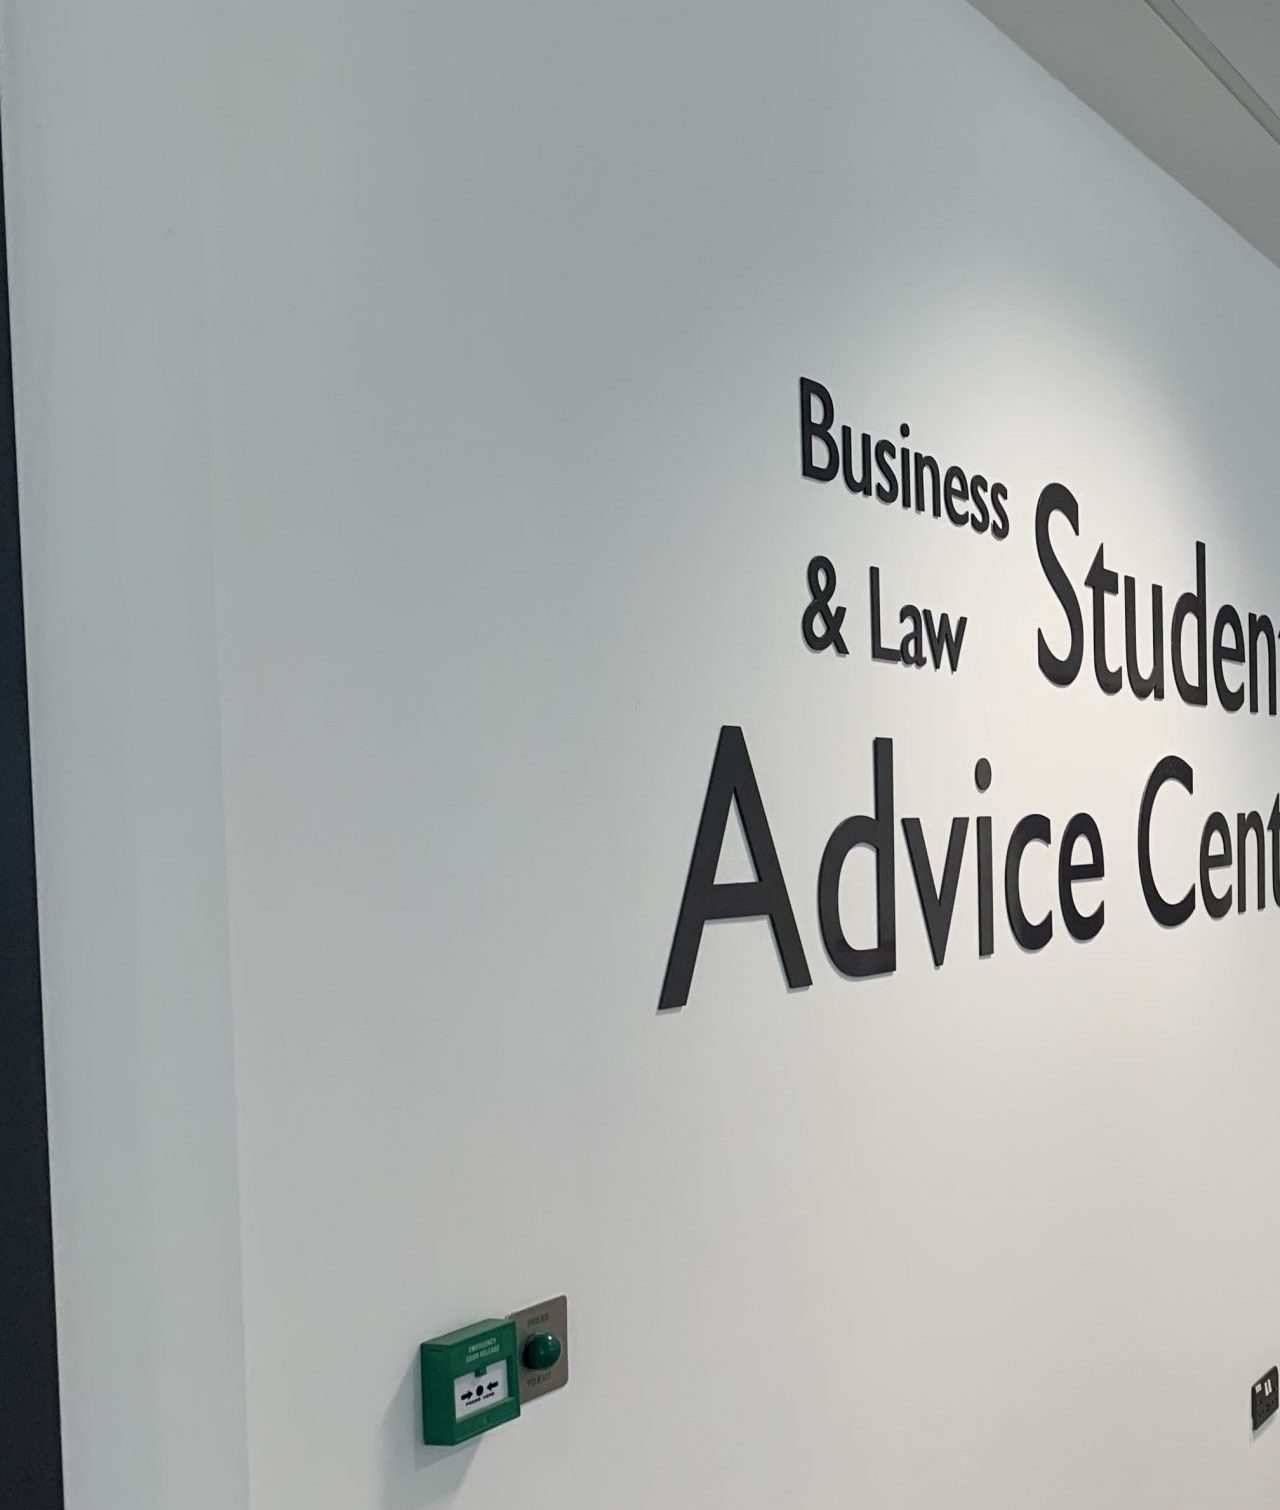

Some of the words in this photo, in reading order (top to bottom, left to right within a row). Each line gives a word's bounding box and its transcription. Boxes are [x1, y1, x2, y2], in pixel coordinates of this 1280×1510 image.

[799, 376, 1010, 540] Business
[801, 555, 851, 655] &
[869, 566, 968, 673] Law
[657, 725, 1105, 1011] Advice
[468, 1338, 496, 1353] EMERGENCY
[480, 1346, 499, 1357] RELEASE
[528, 1313, 549, 1326] PRESS
